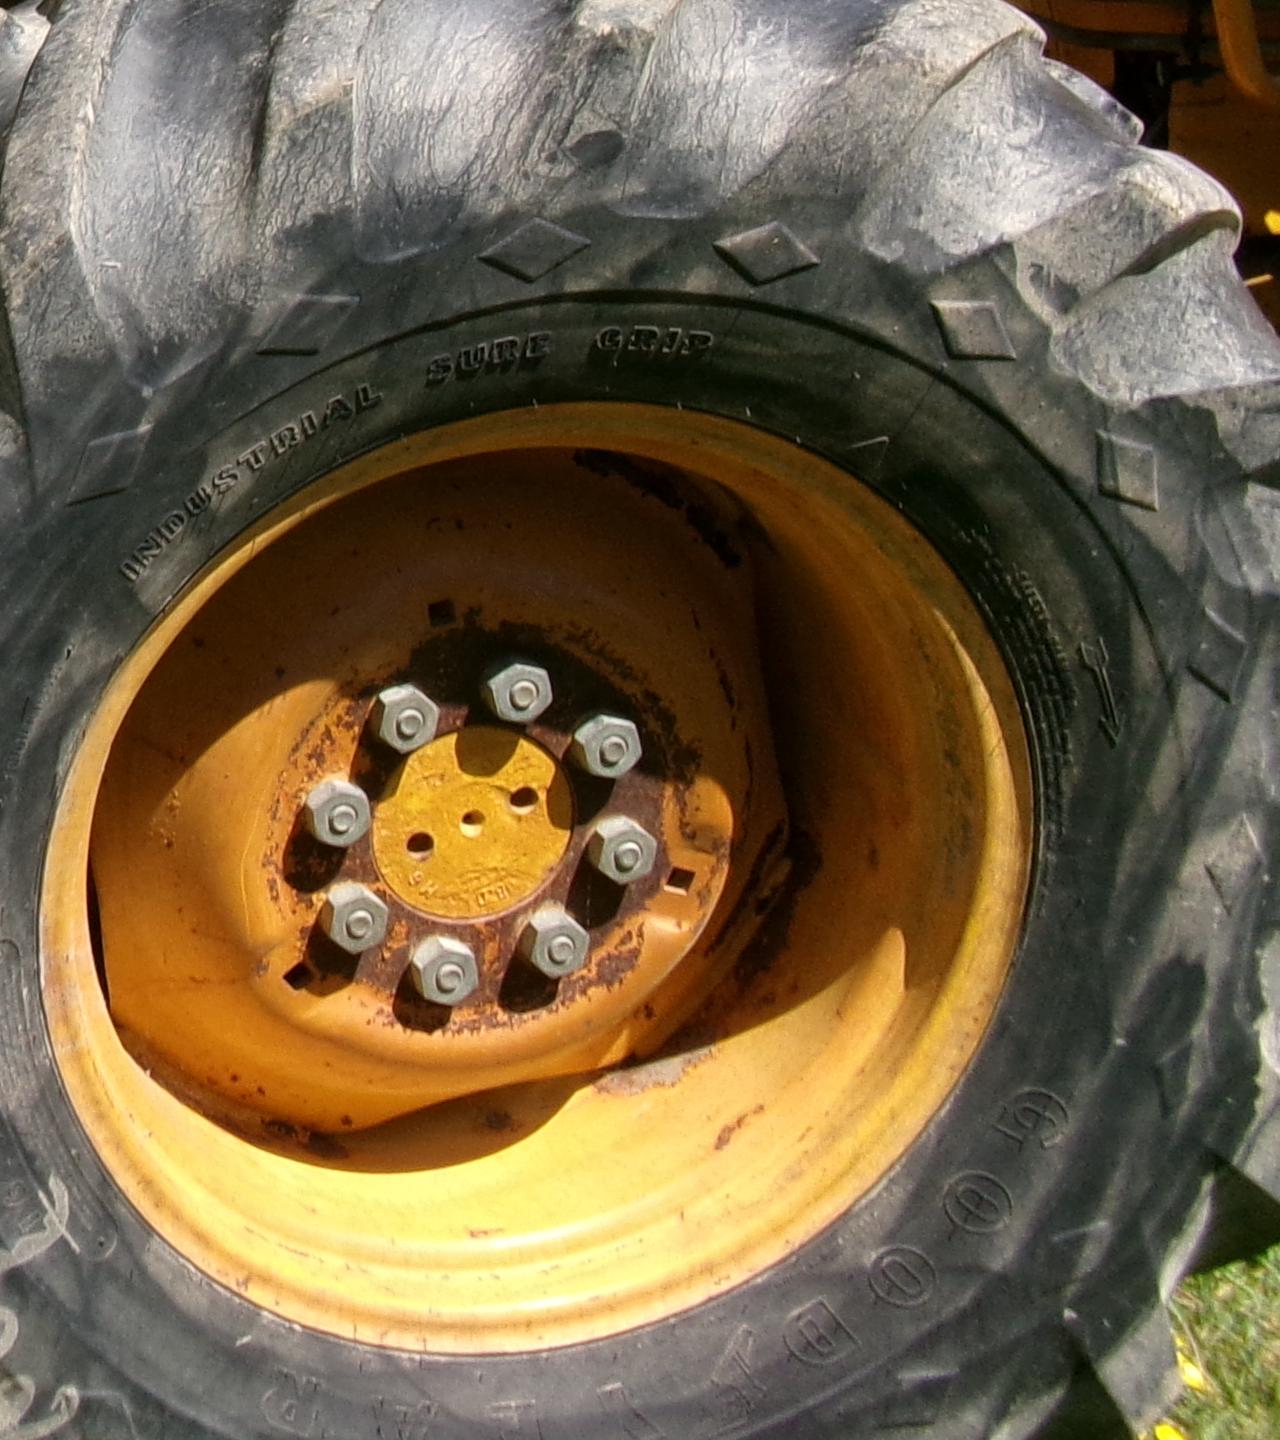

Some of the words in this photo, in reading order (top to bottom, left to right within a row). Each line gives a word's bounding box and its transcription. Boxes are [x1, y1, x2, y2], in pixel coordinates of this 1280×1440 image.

[120, 382, 384, 584] INDUSTRIAL
[425, 330, 552, 386] SURE
[596, 324, 714, 356] GRIP
